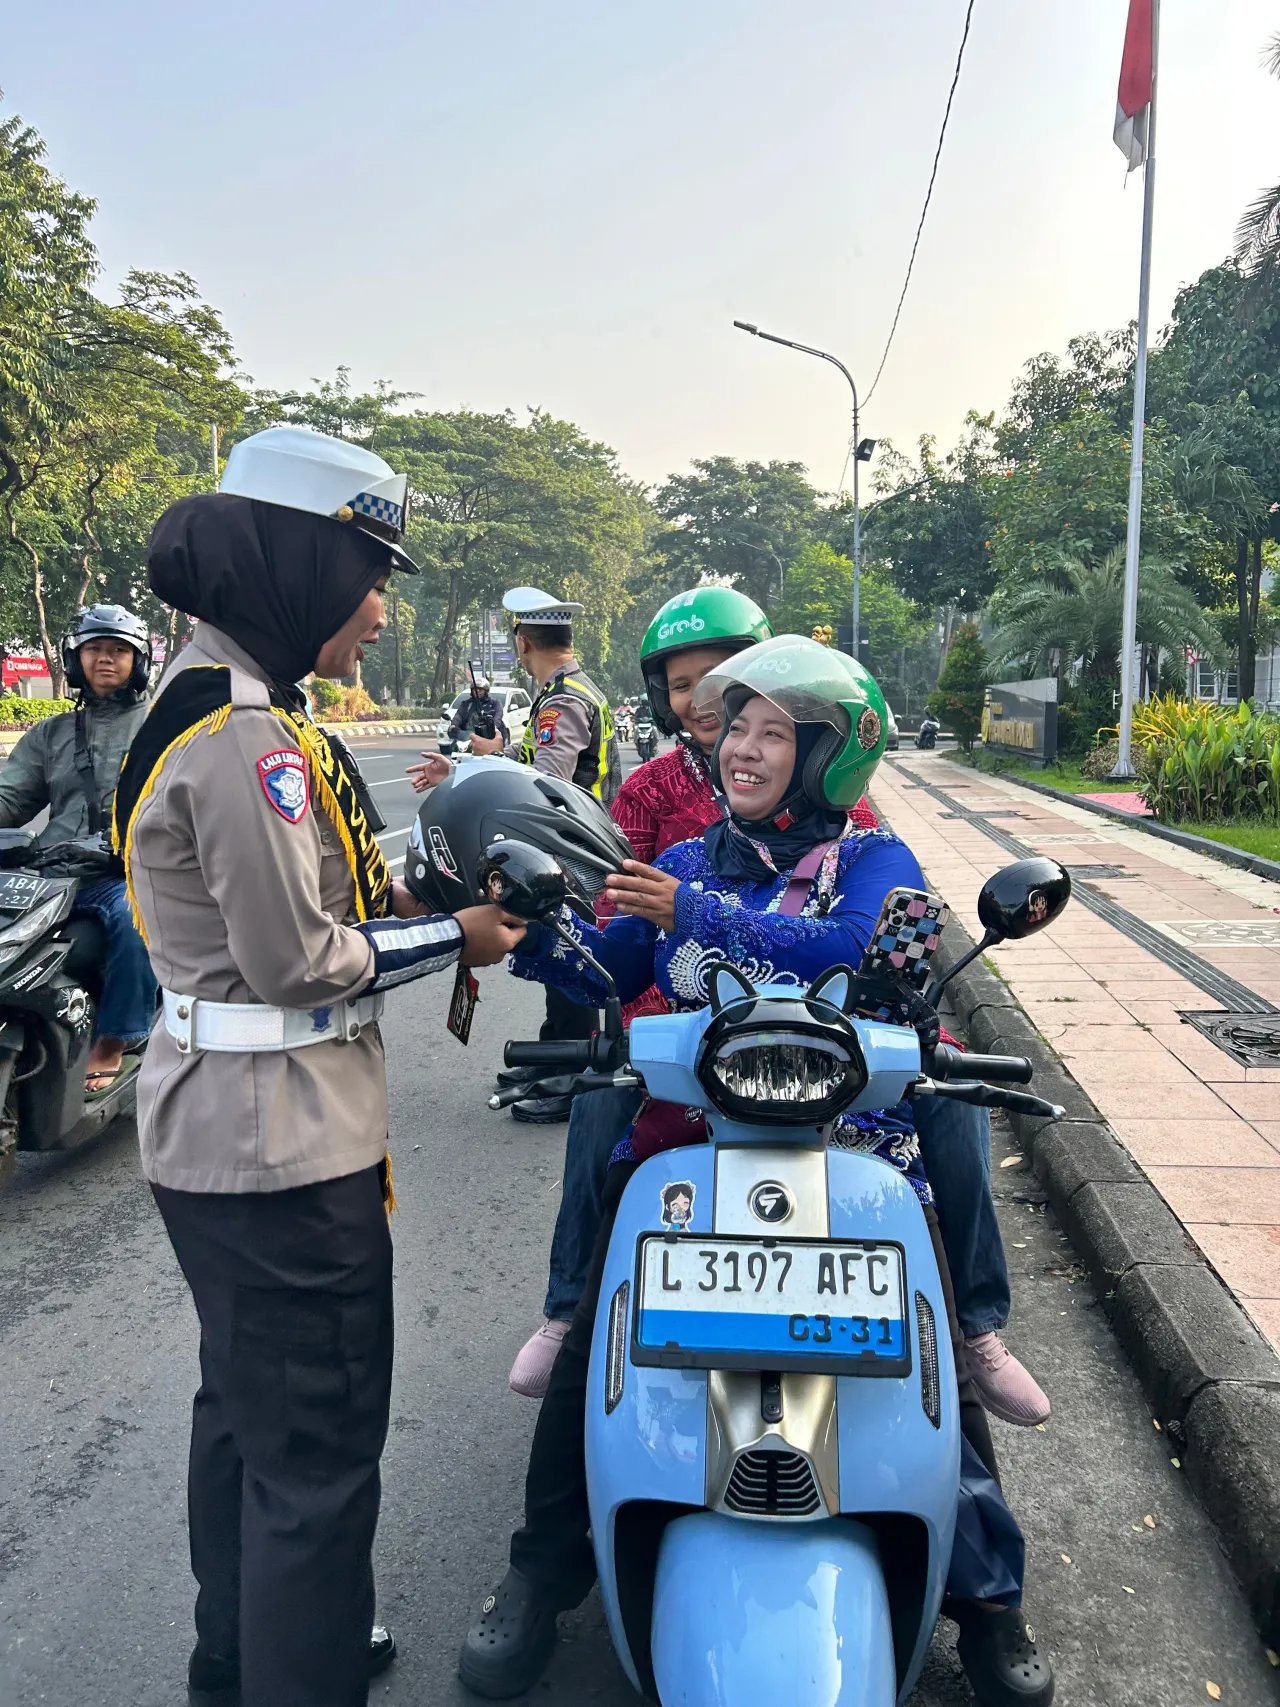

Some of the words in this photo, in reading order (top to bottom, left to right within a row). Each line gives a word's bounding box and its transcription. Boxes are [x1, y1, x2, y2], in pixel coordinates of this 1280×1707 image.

[658, 615, 705, 639] Grab
[260, 752, 282, 770] LALU
[3, 877, 38, 890] ABA
[12, 966, 44, 990] HONDA
[662, 1249, 682, 1291] L
[698, 1250, 793, 1293] 3197
[817, 1251, 889, 1296] AFC
